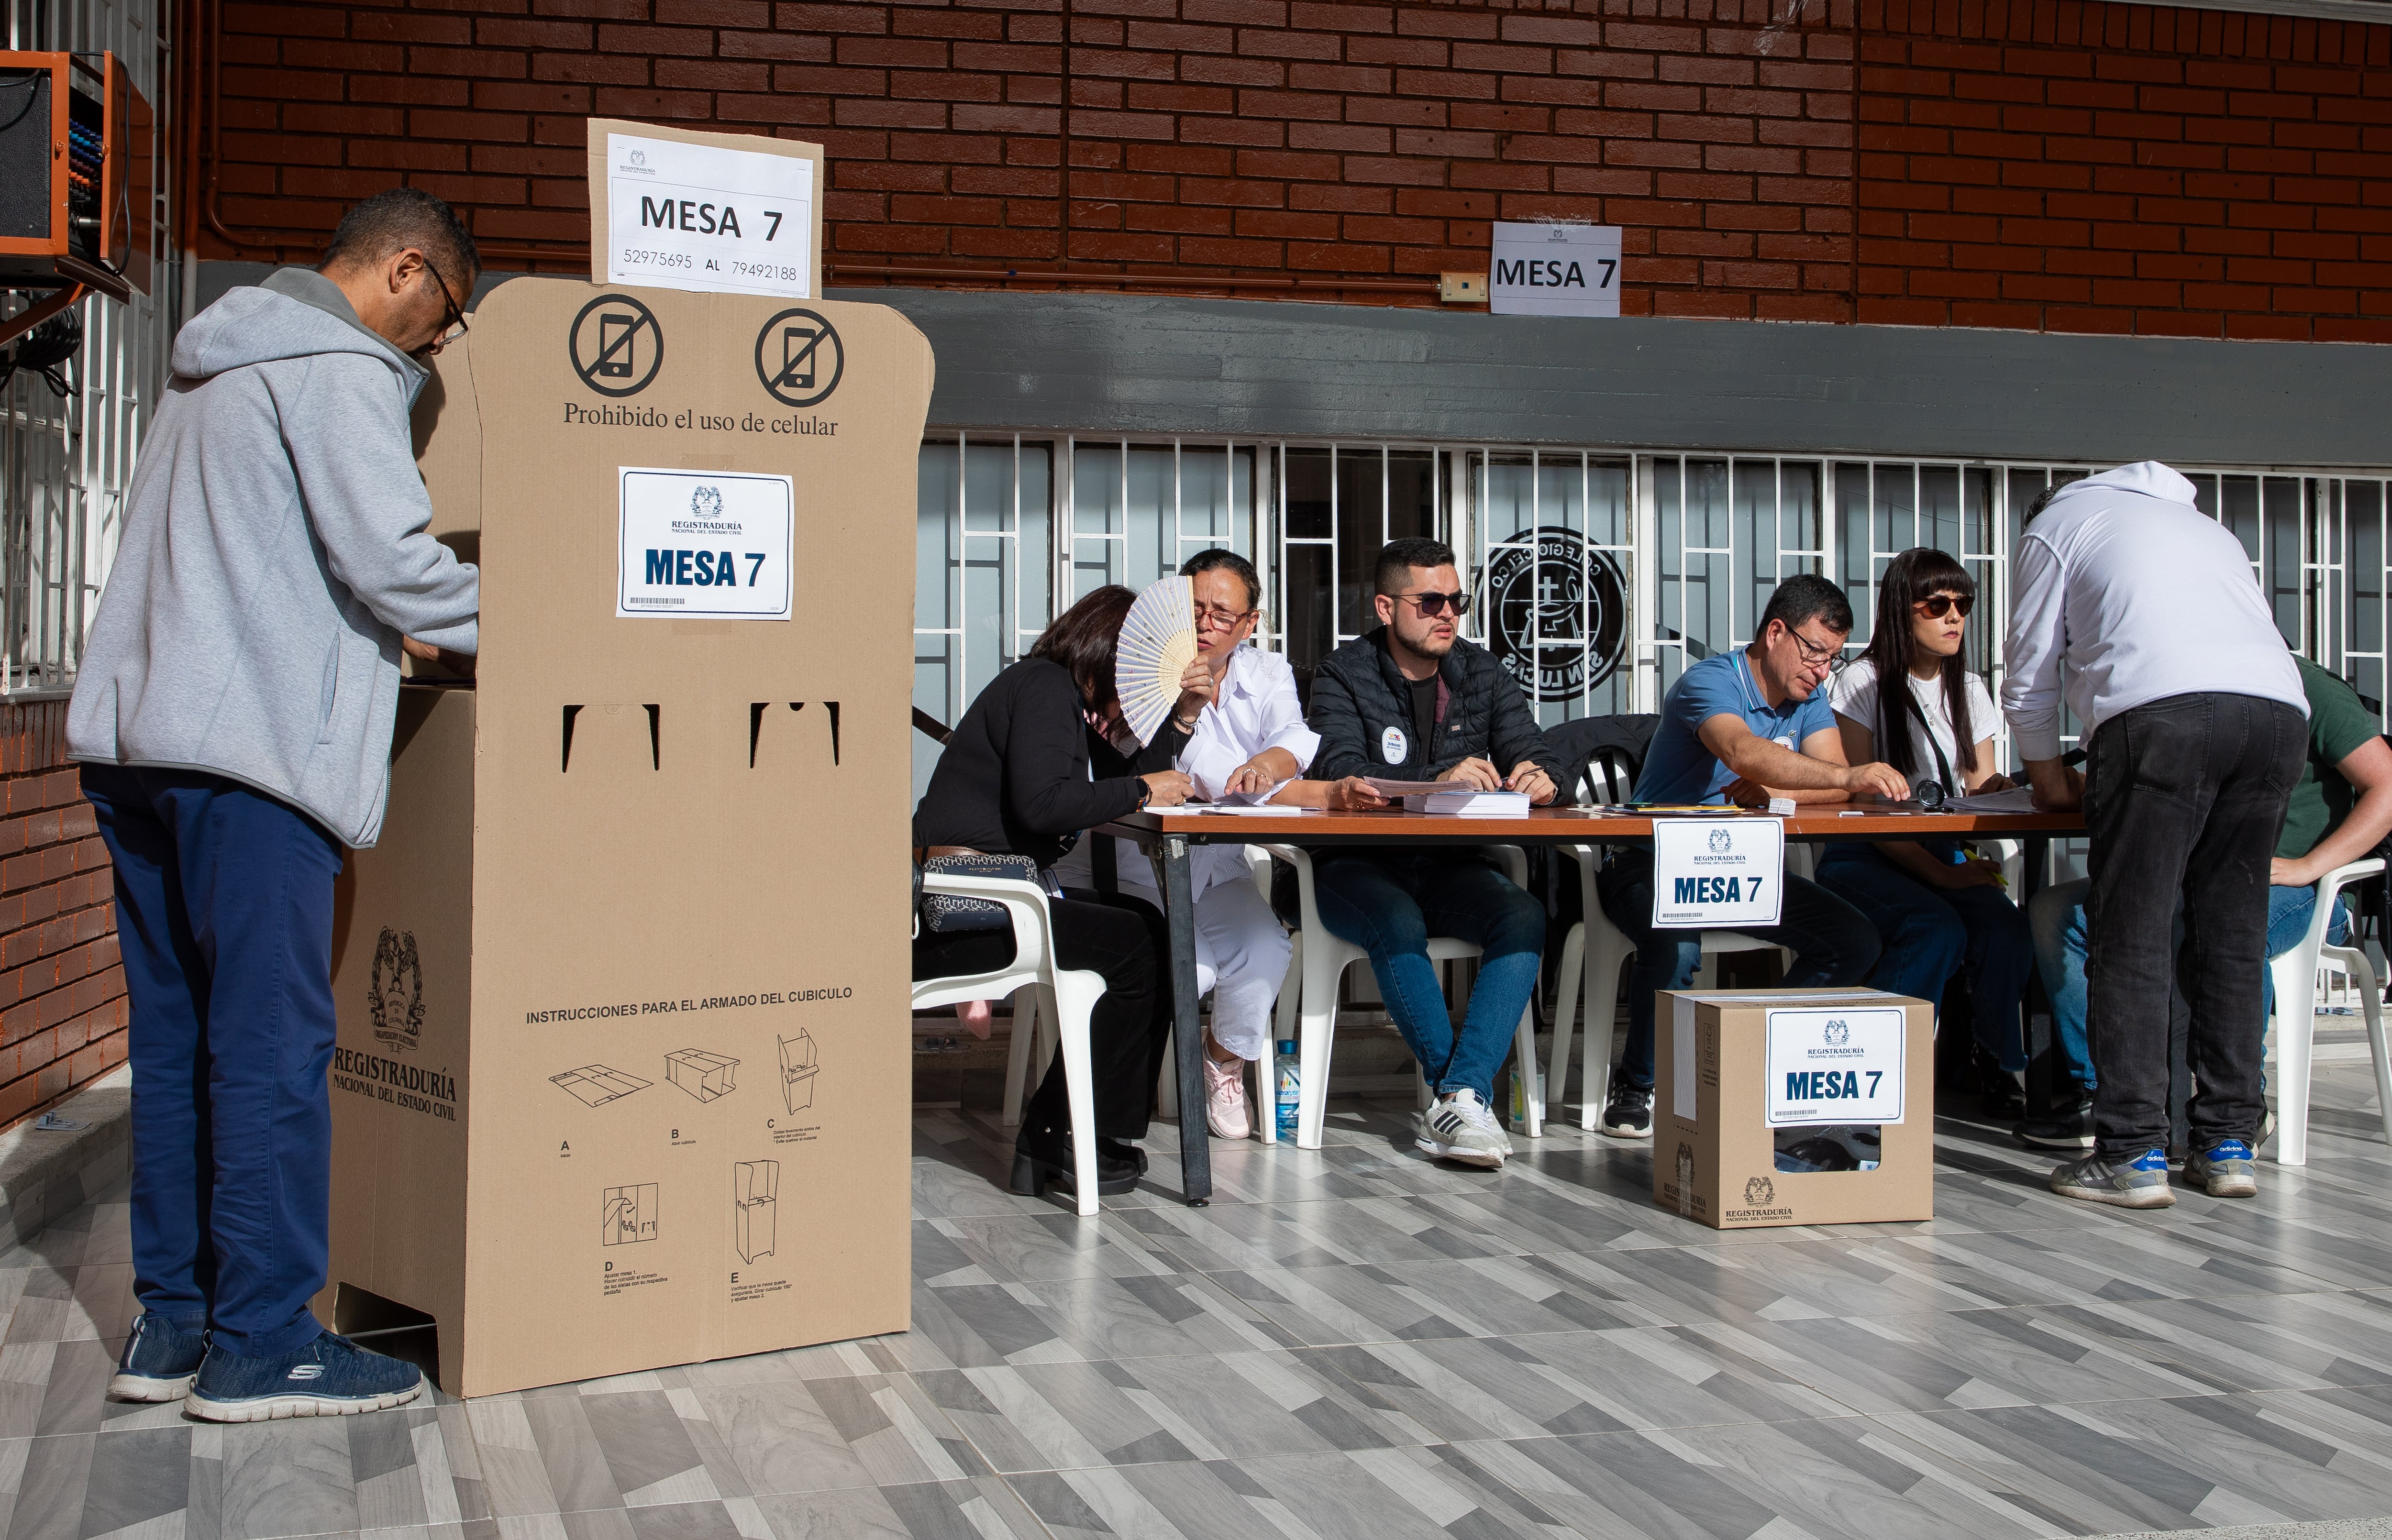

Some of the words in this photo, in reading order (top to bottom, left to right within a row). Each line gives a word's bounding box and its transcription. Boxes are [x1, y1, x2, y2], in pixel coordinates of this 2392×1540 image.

[642, 196, 741, 238] MESA
[764, 210, 783, 241] 7
[623, 249, 692, 269] 52975695
[706, 259, 720, 272] AL
[732, 261, 797, 281] 79492188
[1496, 259, 1586, 288] MESA
[1597, 259, 1617, 288] 7
[564, 402, 668, 429] Prohibido
[675, 409, 693, 430] el
[700, 415, 735, 431] uso
[741, 412, 765, 433] de
[771, 415, 838, 436] celular
[672, 520, 742, 530] REGISTRADURÍA
[646, 549, 737, 587] MESA
[745, 553, 766, 587] 7
[1674, 877, 1740, 904] MESA
[1748, 877, 1762, 902] 7
[526, 1003, 638, 1024] INSTRUCCIONES
[642, 1001, 678, 1015] PARA
[681, 1000, 698, 1012] EL
[699, 994, 757, 1010] ARMADO
[761, 991, 785, 1005] DEL
[788, 987, 853, 1003] CUBICULO
[1808, 1046, 1864, 1055] REGISTRADURÍA
[334, 1046, 457, 1102] REGISTRADURÍA
[1786, 1071, 1860, 1100] MESA
[1866, 1071, 1883, 1099] 7
[333, 1074, 376, 1098] NACIONAL
[378, 1086, 395, 1103] DEL
[397, 1090, 431, 1114] ESTADO
[433, 1102, 456, 1122] CIVIL
[671, 1129, 679, 1139] B
[767, 1119, 775, 1128] C
[561, 1141, 569, 1151] A
[1726, 1206, 1793, 1217] REGISTRADURÍA
[605, 1262, 613, 1271] D
[731, 1272, 739, 1283] E
